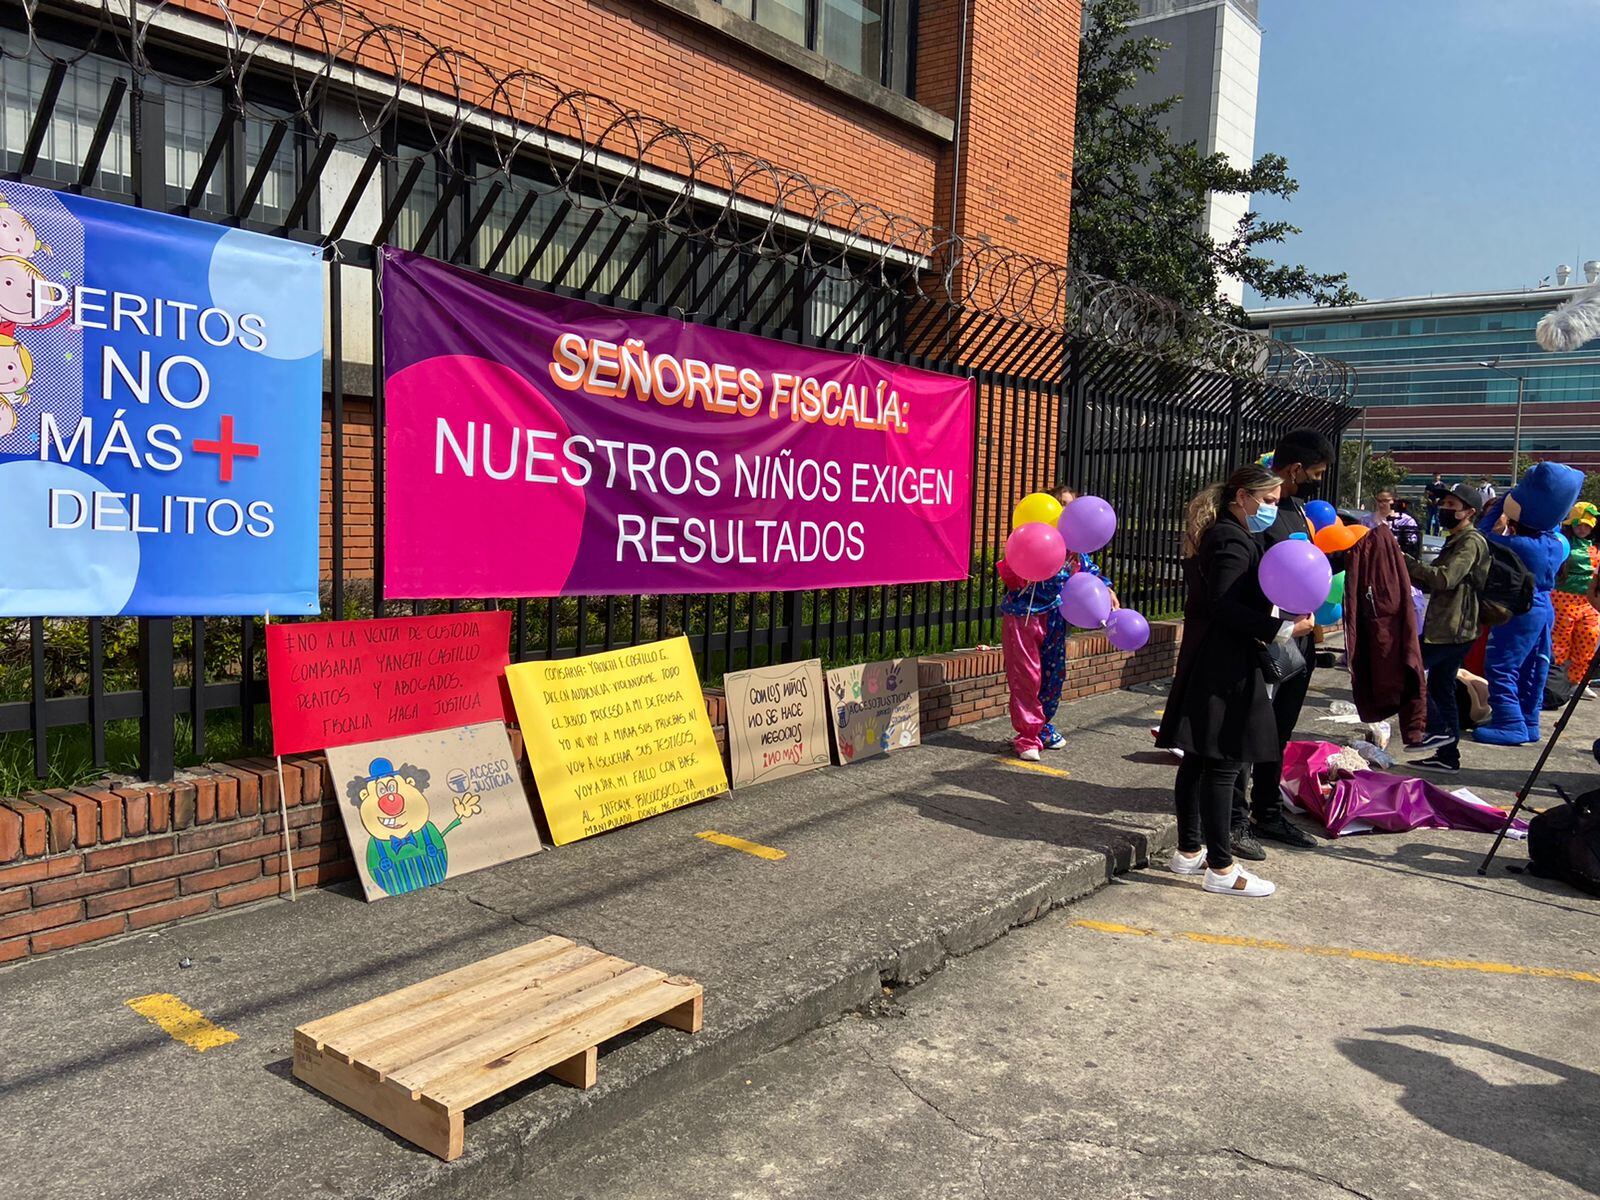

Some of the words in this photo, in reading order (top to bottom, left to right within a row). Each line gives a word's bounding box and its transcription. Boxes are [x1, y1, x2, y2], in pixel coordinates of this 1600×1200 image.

[32, 279, 268, 353] PERITOS
[103, 346, 210, 410] NO
[550, 332, 763, 414] SEÑORES
[769, 372, 909, 434] FISCALÍA:
[40, 408, 183, 472] MÁS
[436, 417, 721, 498] NUESTROS
[735, 449, 841, 502] NIÑOS
[852, 464, 953, 505] EXIGEN
[48, 488, 275, 538] DELITOS
[616, 514, 864, 563] RESULTADOS
[327, 632, 334, 648] A
[342, 631, 356, 647] LA
[364, 627, 399, 643] VENTA
[409, 627, 422, 640] DE
[427, 622, 479, 640] CUSTODIA
[291, 657, 361, 683] COMISARIA
[376, 651, 422, 673] YANETH
[428, 644, 480, 666] CASTILLO
[661, 666, 680, 680] TODO
[297, 687, 350, 711] PERITOS
[373, 681, 382, 700] Y
[394, 672, 463, 696] ABOGADOS.
[767, 682, 780, 703] LOS
[783, 676, 808, 698] NIÑOS
[323, 713, 373, 736] FISCALIA
[388, 704, 418, 723] HAGA
[433, 693, 481, 715] JUSTICIA
[552, 718, 563, 730] EL
[590, 705, 623, 723] PROCESO
[626, 702, 633, 714] A
[634, 698, 643, 711] MI
[645, 691, 684, 709] DEFENSA
[748, 712, 763, 728] NO
[765, 709, 778, 726] SE
[781, 703, 804, 718] HACE
[558, 738, 571, 751] YO
[587, 732, 598, 746] VOY
[604, 732, 610, 744] A
[614, 726, 637, 740] MIRAR
[637, 723, 653, 735] SUS
[655, 714, 686, 730] PRUEBAS
[761, 724, 802, 746] NEGOCIOS
[470, 759, 509, 779] ACCESO
[566, 760, 585, 776] VOY
[587, 756, 595, 770] A
[636, 745, 652, 757] SUS
[574, 785, 593, 800] VOY
[595, 782, 601, 794] A
[616, 775, 627, 787] MI
[633, 767, 656, 784] FALLO
[660, 760, 676, 773] CON
[679, 752, 699, 769] BASE
[474, 772, 514, 793] JUSTICIA
[582, 810, 595, 824] AL
